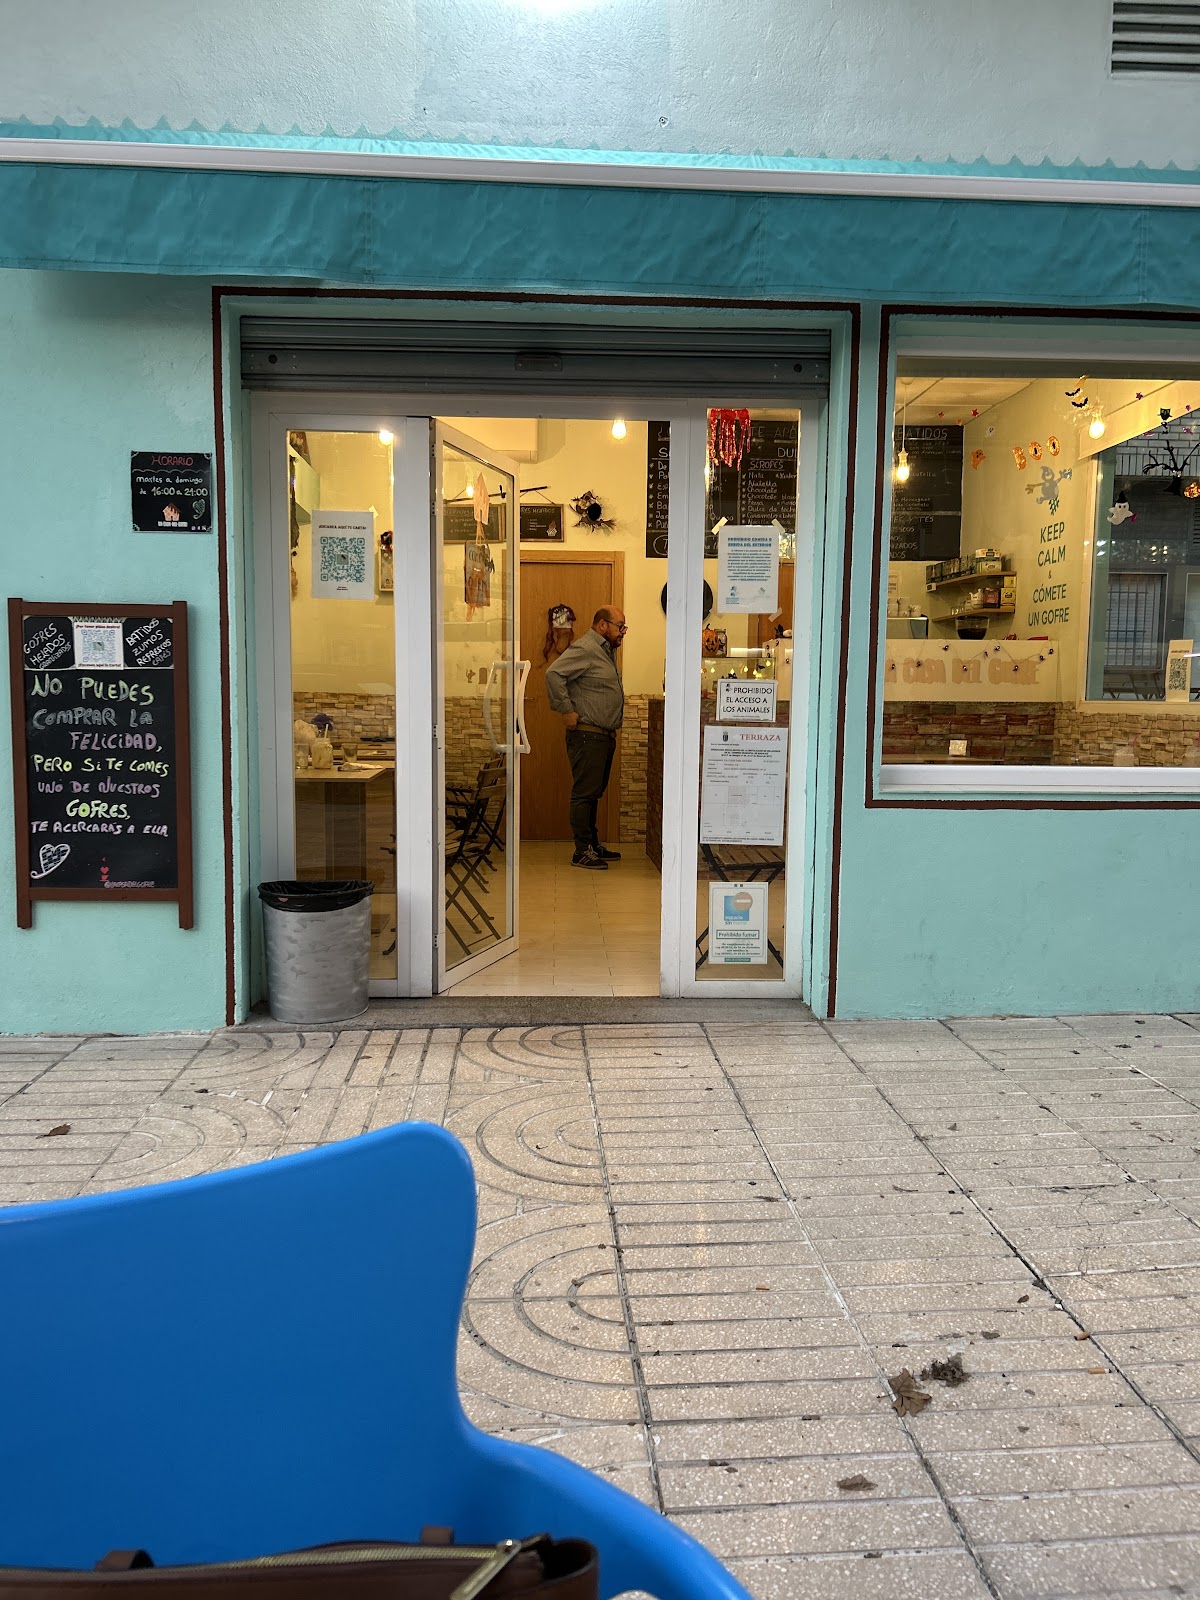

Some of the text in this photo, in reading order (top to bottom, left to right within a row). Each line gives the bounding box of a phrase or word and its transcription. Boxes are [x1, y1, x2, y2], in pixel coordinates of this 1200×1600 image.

[152, 456, 194, 466] HORARIO
[176, 476, 202, 485] domingo
[151, 487, 175, 496] 16:00
[184, 488, 208, 498] 21:00
[1040, 522, 1064, 544] KEEP
[1037, 545, 1066, 567] CALM
[1048, 570, 1052, 580] &
[1032, 583, 1067, 604] CÓMETE
[1028, 607, 1070, 626] UN GOFRE
[24, 623, 57, 654] GOFRES
[30, 634, 65, 665] HELADOS
[132, 630, 163, 656] ZUMOS
[136, 639, 171, 666] REFRESCOS
[31, 673, 154, 706] NO PUEDES
[33, 706, 153, 729] COMPRAR LA
[69, 732, 162, 752] FELICIDAD,
[30, 754, 72, 772] PERO
[105, 758, 123, 771] TE
[129, 760, 169, 777] COMES
[38, 776, 160, 798] UNO DE NUESTROS
[66, 799, 130, 820] GOFRES,
[30, 821, 49, 834] TE
[127, 825, 135, 834] A
[143, 824, 168, 837] ELLA
